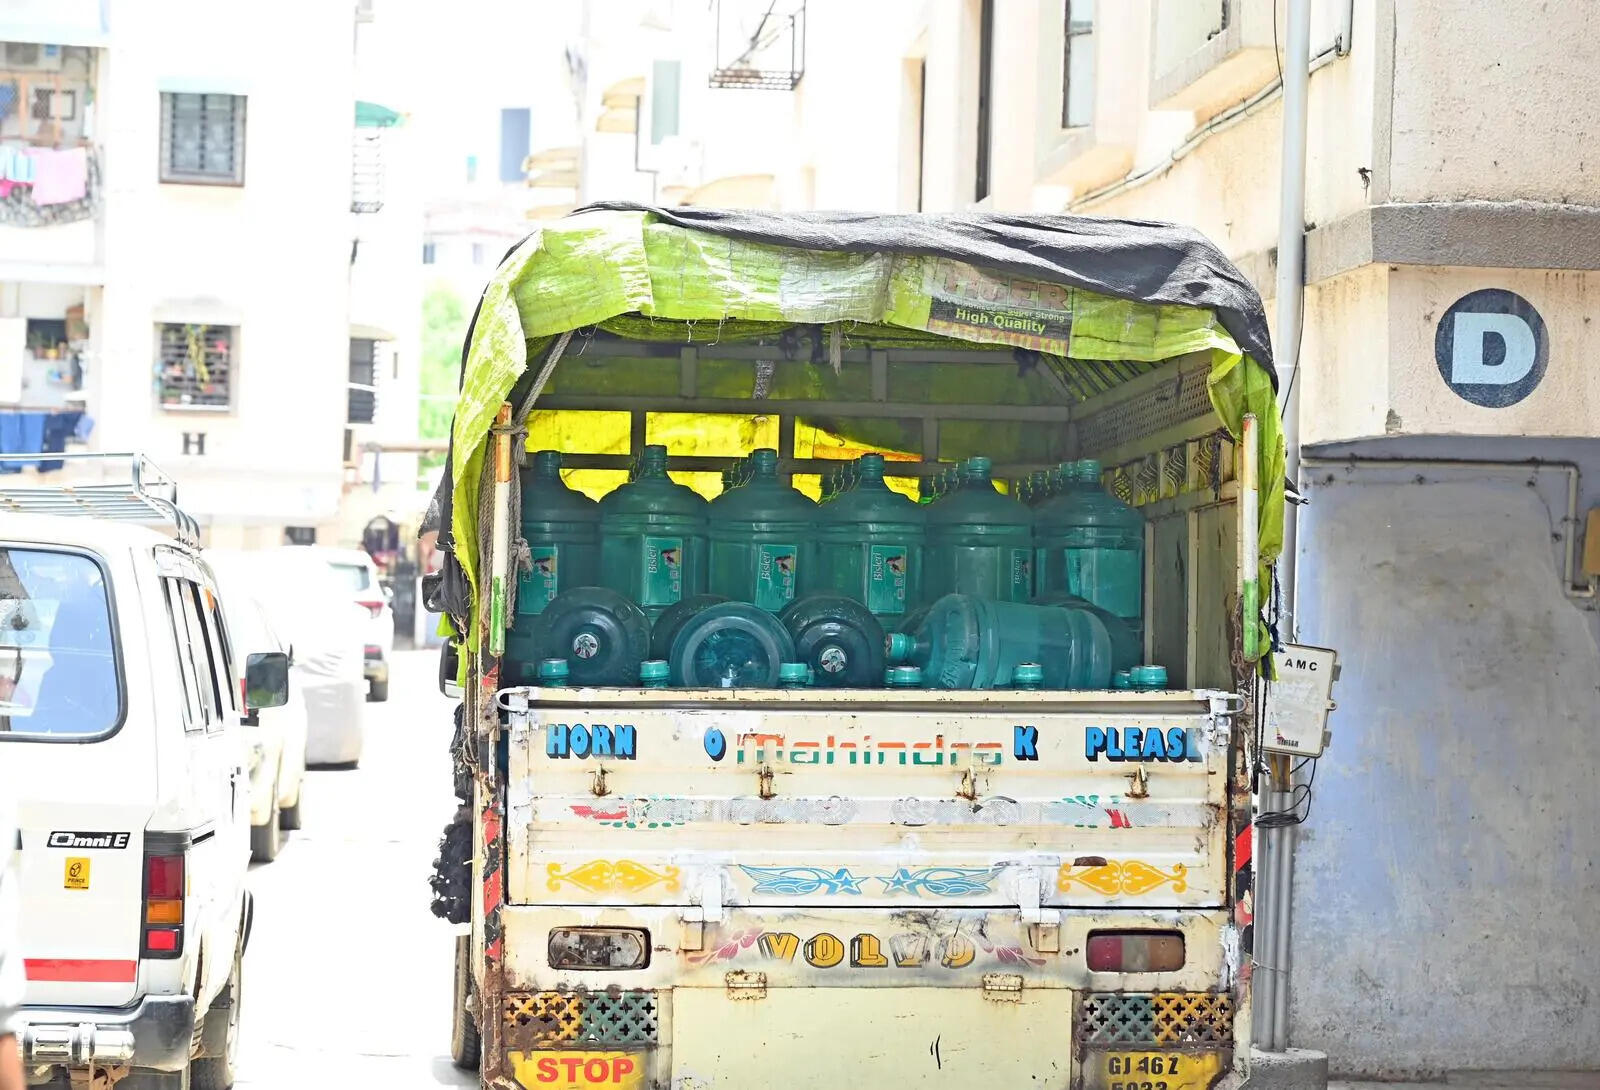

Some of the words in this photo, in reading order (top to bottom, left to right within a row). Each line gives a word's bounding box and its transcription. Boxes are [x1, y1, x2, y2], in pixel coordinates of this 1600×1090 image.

[955, 307, 988, 325] High
[993, 315, 1046, 334] Quality
[1452, 312, 1536, 384] D
[181, 432, 206, 455] H
[648, 543, 657, 573] Bisleri
[761, 551, 771, 580] Bisleri
[872, 552, 882, 581] Bisleri
[546, 724, 637, 760] HORN
[703, 727, 726, 761] O
[1014, 726, 1038, 760] K
[50, 833, 112, 847] Omni
[113, 834, 128, 847] E
[757, 932, 976, 969] VOLVO
[537, 1058, 634, 1083] STOP
[1108, 1057, 1131, 1075] GJ
[1168, 1057, 1178, 1074] Z
